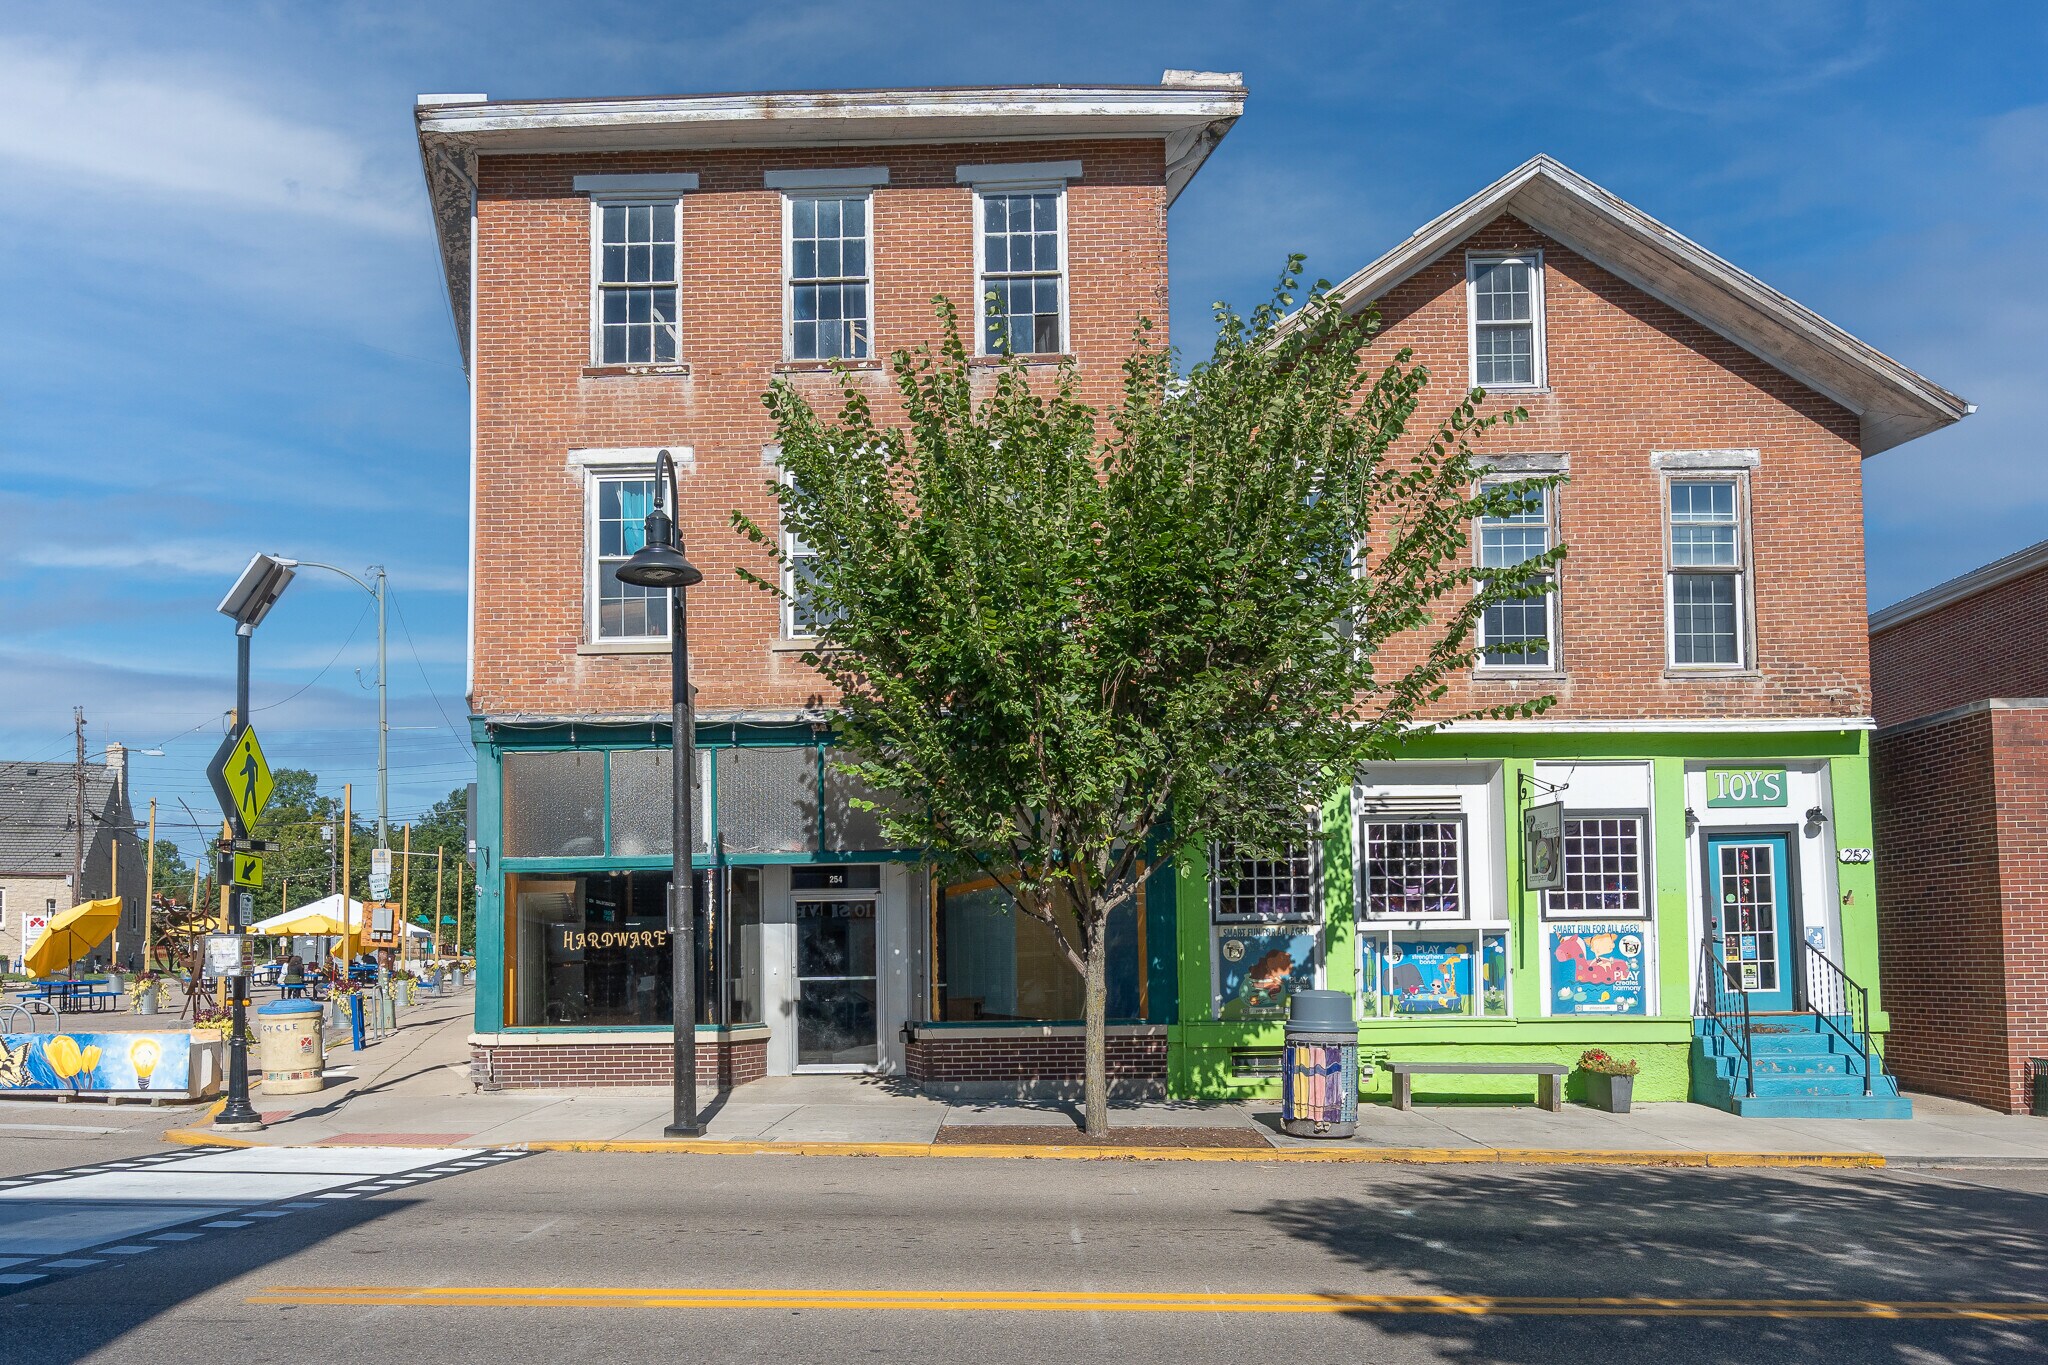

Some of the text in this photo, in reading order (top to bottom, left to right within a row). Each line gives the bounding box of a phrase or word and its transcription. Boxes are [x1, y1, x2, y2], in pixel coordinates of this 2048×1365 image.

[1714, 771, 1781, 801] TOYS
[1844, 848, 1871, 862] 252
[829, 875, 843, 884] 254
[1223, 928, 1246, 937] SMART
[1248, 928, 1261, 937] FUN
[1278, 928, 1289, 937] ALL
[1552, 923, 1640, 933] SMART FUN FOR ALL AGES!
[563, 930, 667, 951] HARDWARE
[1416, 945, 1440, 954] PLAY
[1289, 976, 1309, 984] PLAY
[1614, 971, 1640, 981] PLAY
[261, 1023, 299, 1032] CYCLE
